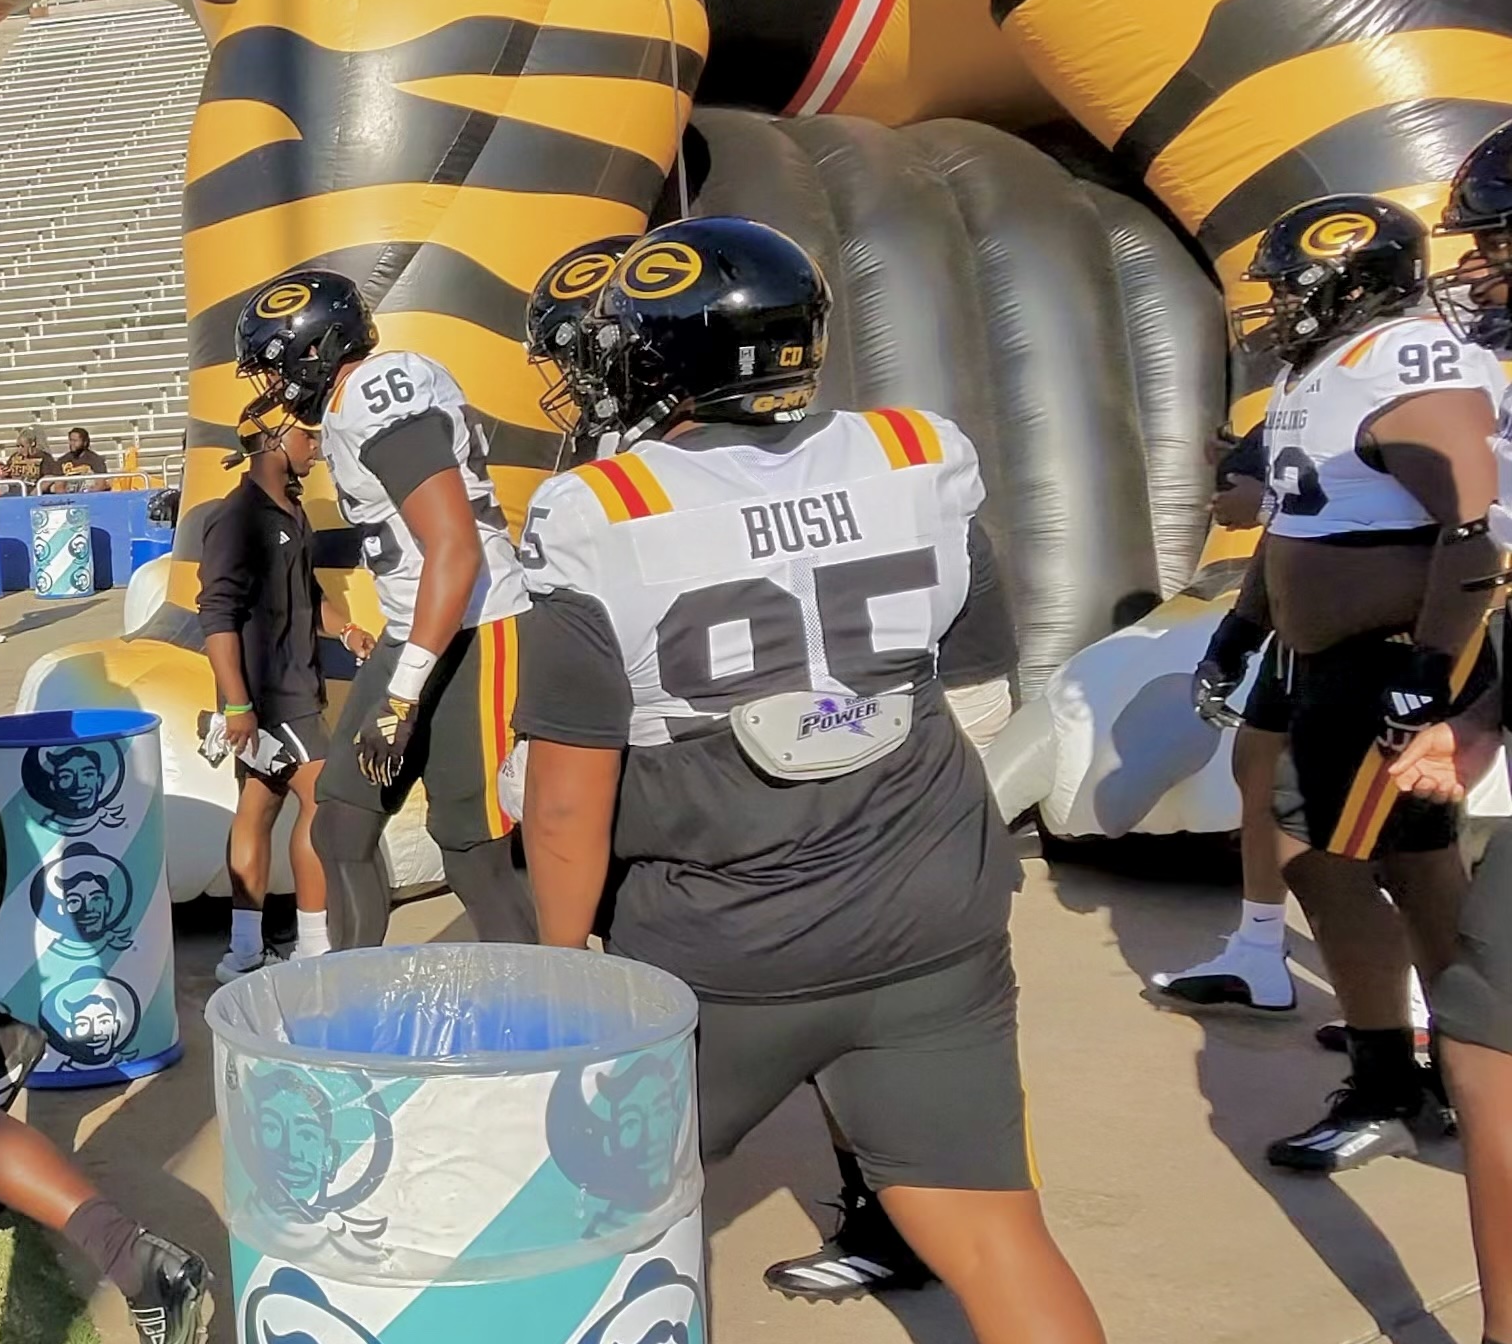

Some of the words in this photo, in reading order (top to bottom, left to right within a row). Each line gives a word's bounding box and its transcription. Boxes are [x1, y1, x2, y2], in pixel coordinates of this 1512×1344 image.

[1397, 339, 1463, 385] 92
[361, 367, 416, 415] 56
[740, 490, 863, 560] BUSH
[797, 700, 881, 741] POWER
